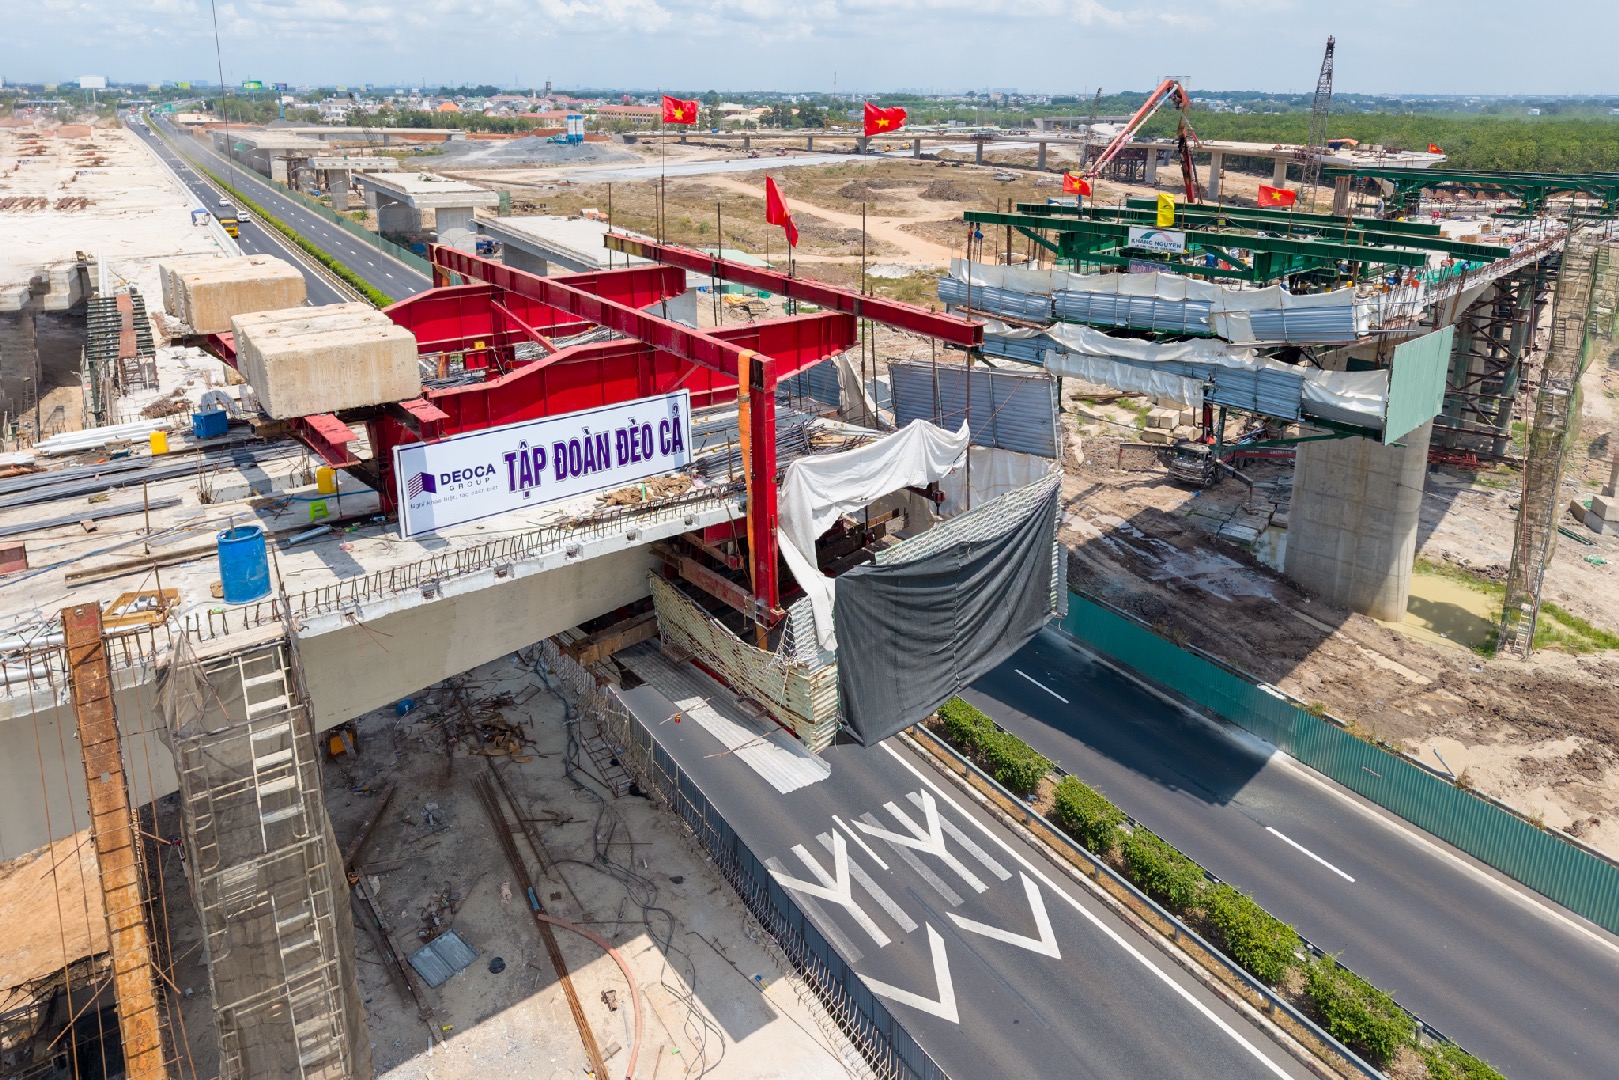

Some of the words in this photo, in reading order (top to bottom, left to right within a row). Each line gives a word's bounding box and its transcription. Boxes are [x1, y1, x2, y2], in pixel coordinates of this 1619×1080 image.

[502, 439, 548, 500] TẬP
[552, 426, 612, 483] ĐOÀN
[615, 417, 654, 468] ĐÈO
[658, 402, 685, 457] CẢ
[440, 463, 496, 486] DEOCA
[449, 477, 490, 491] GROUP
